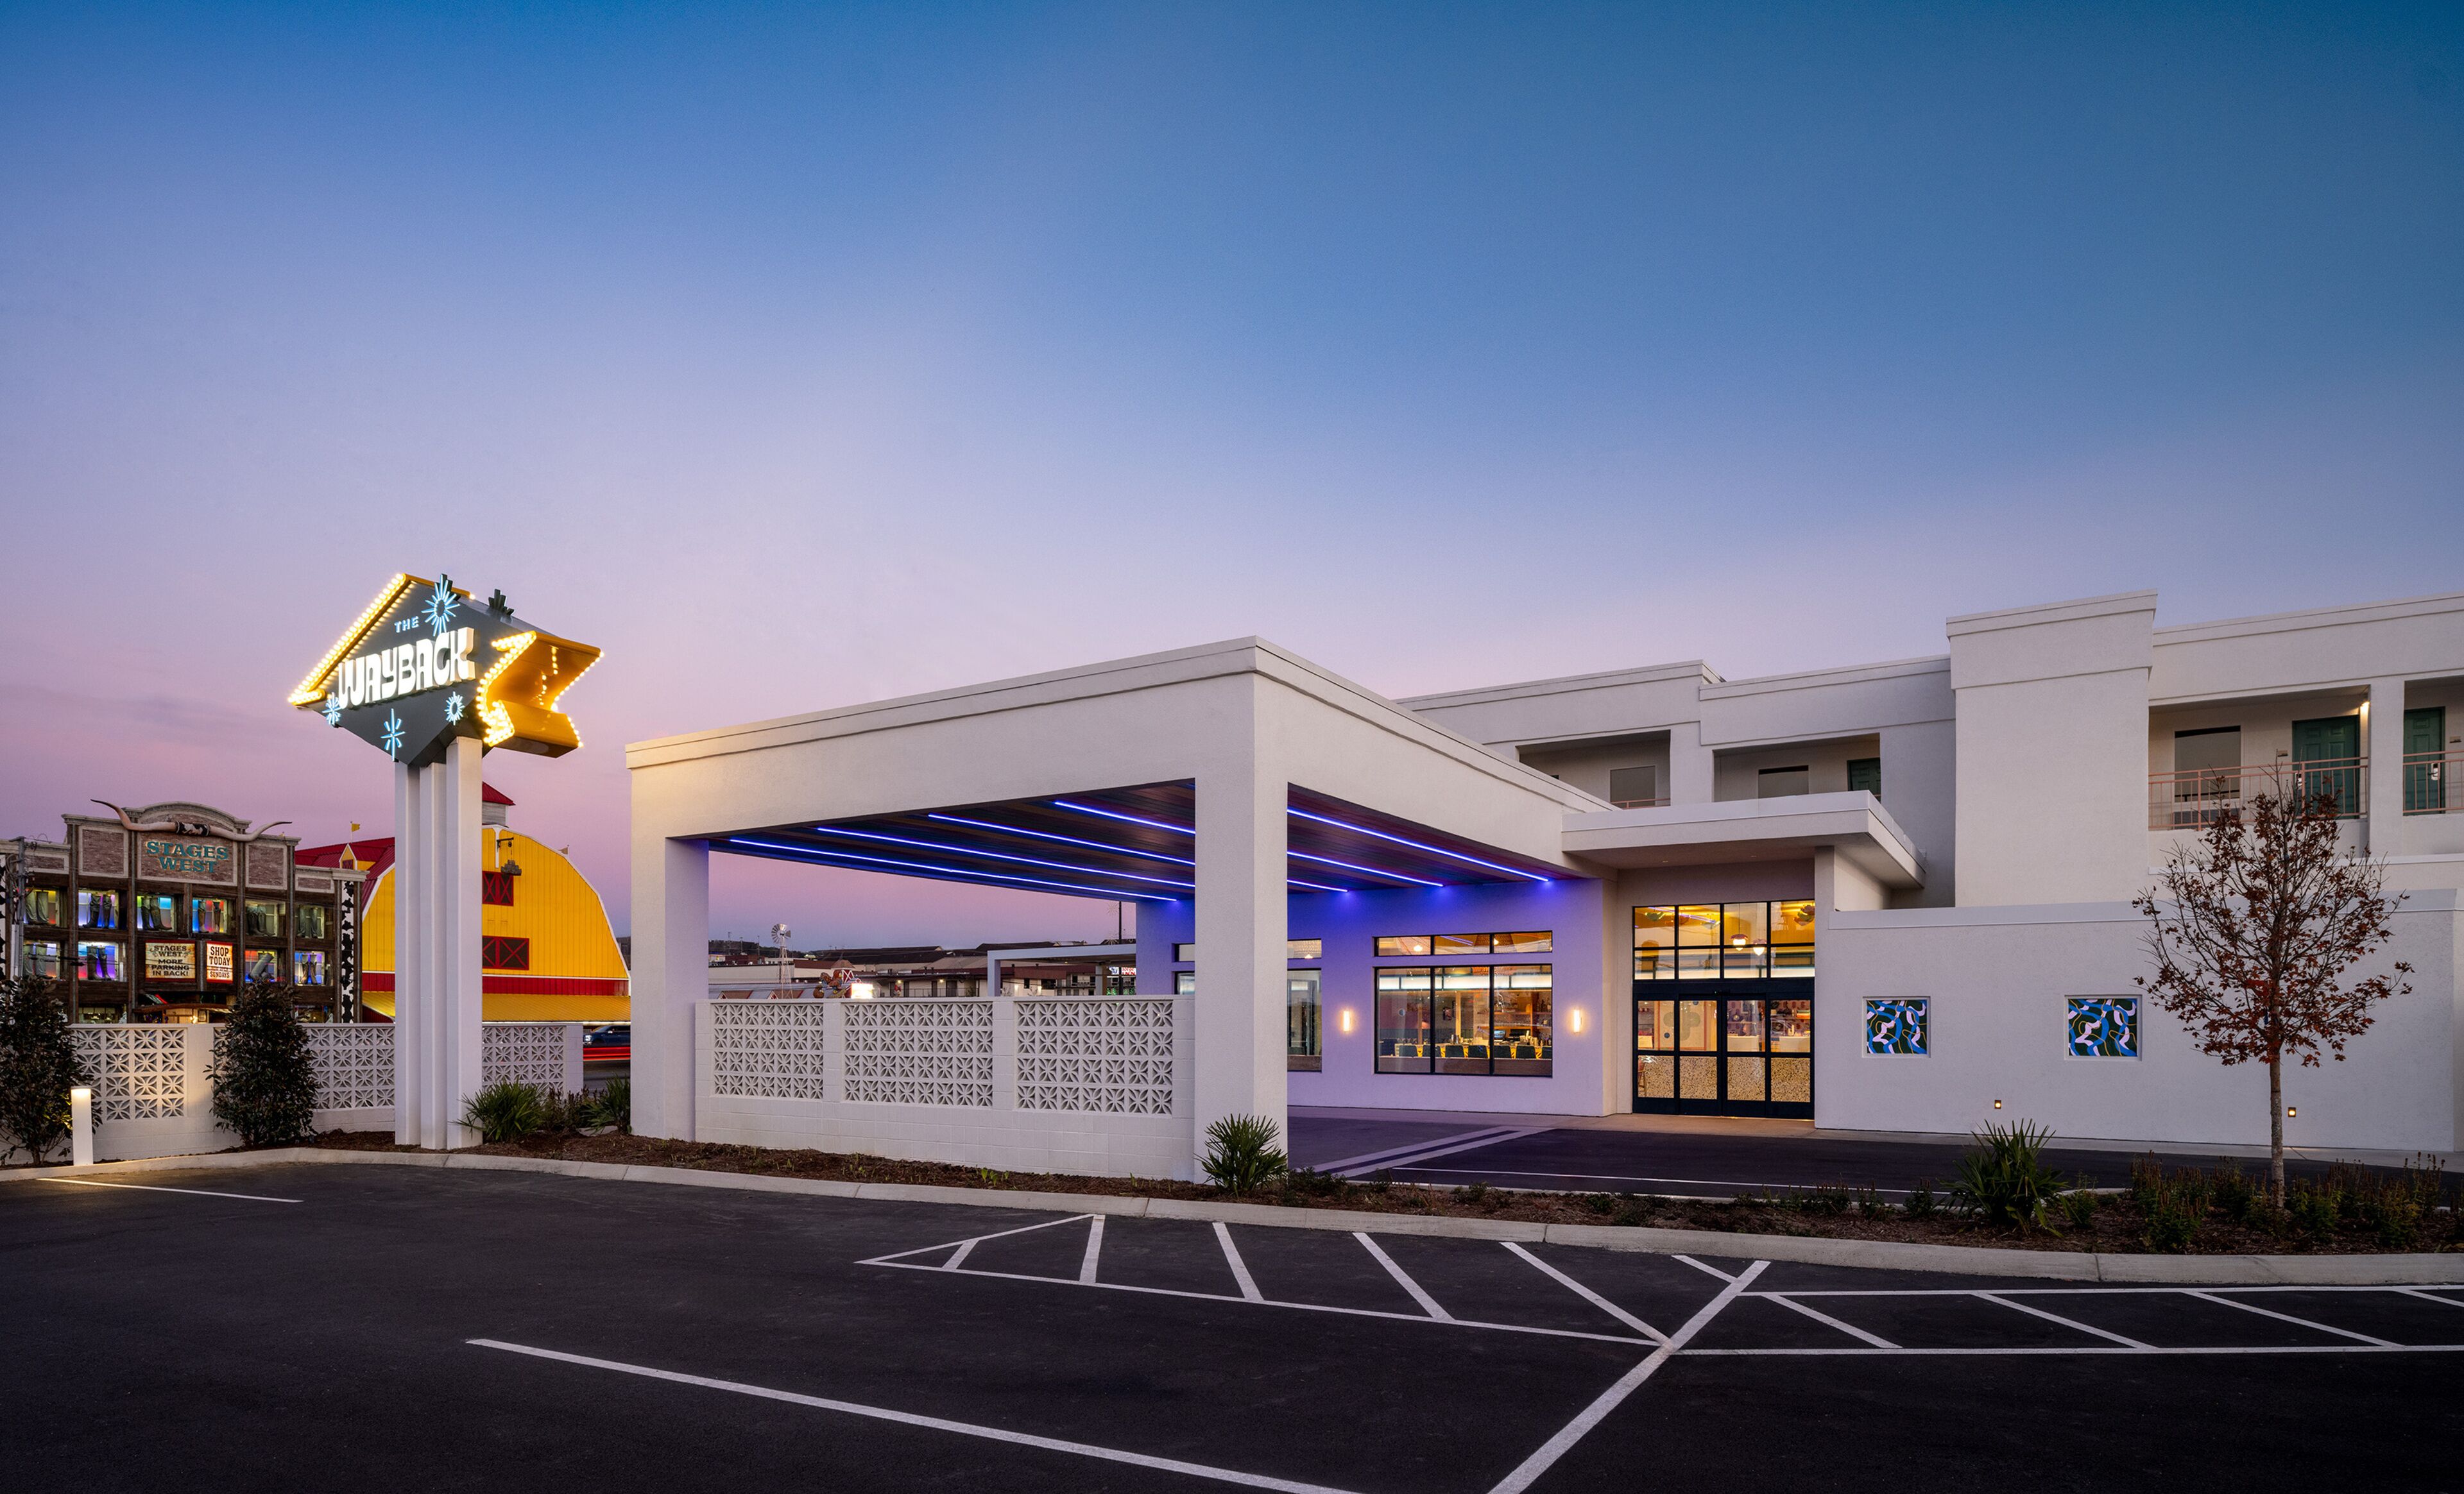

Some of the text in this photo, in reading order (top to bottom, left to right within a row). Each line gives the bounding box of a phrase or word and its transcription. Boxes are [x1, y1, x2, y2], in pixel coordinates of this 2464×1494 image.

[394, 616, 420, 633] THE
[338, 627, 475, 709] WAYBACK
[146, 840, 228, 860] STAGES
[158, 856, 217, 872] WEST
[210, 946, 230, 956] SHOP
[209, 956, 231, 966] TODAY
